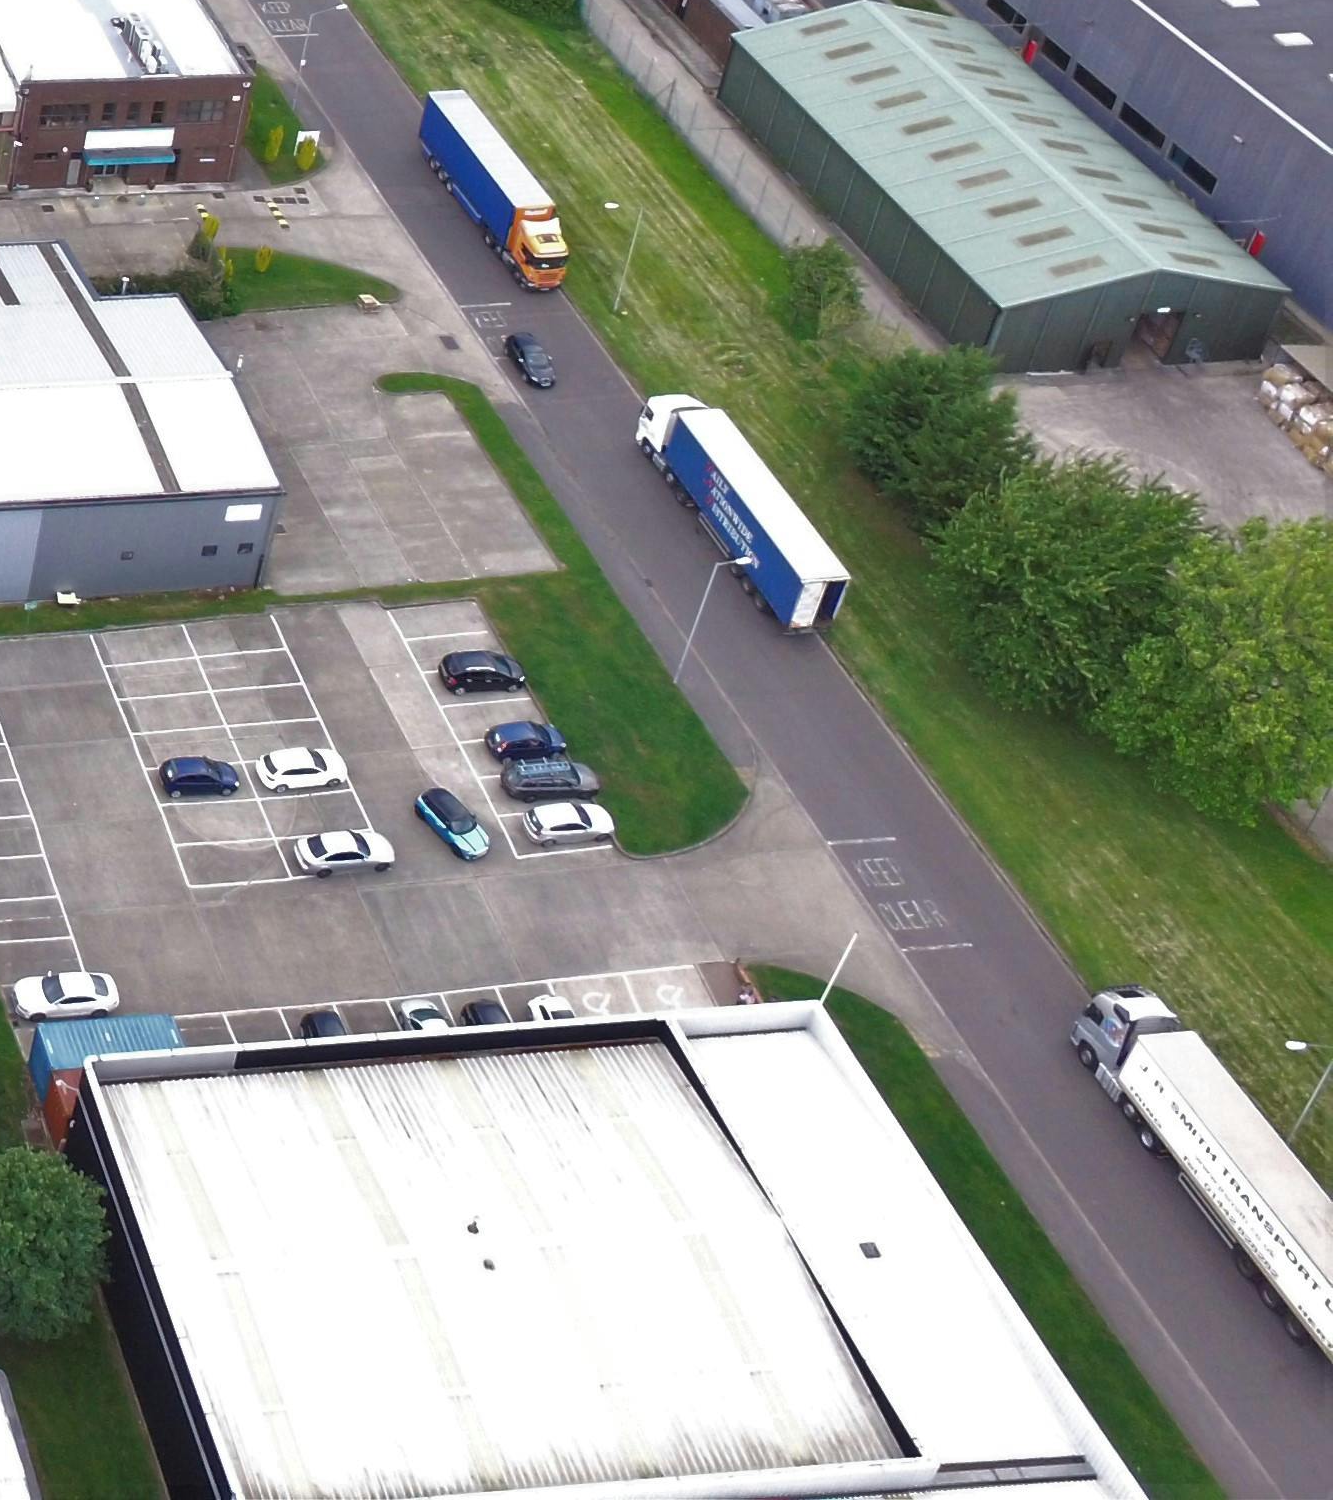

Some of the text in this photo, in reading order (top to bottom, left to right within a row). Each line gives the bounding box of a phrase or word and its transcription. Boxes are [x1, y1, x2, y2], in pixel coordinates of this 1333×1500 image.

[259, 1, 291, 14] KEEP
[266, 18, 309, 32] CLEAR
[852, 857, 906, 887] KEEP
[877, 900, 949, 931] CLEAR
[1170, 1101, 1217, 1162] SMITH
[1221, 1166, 1322, 1290] TRANSPORT
